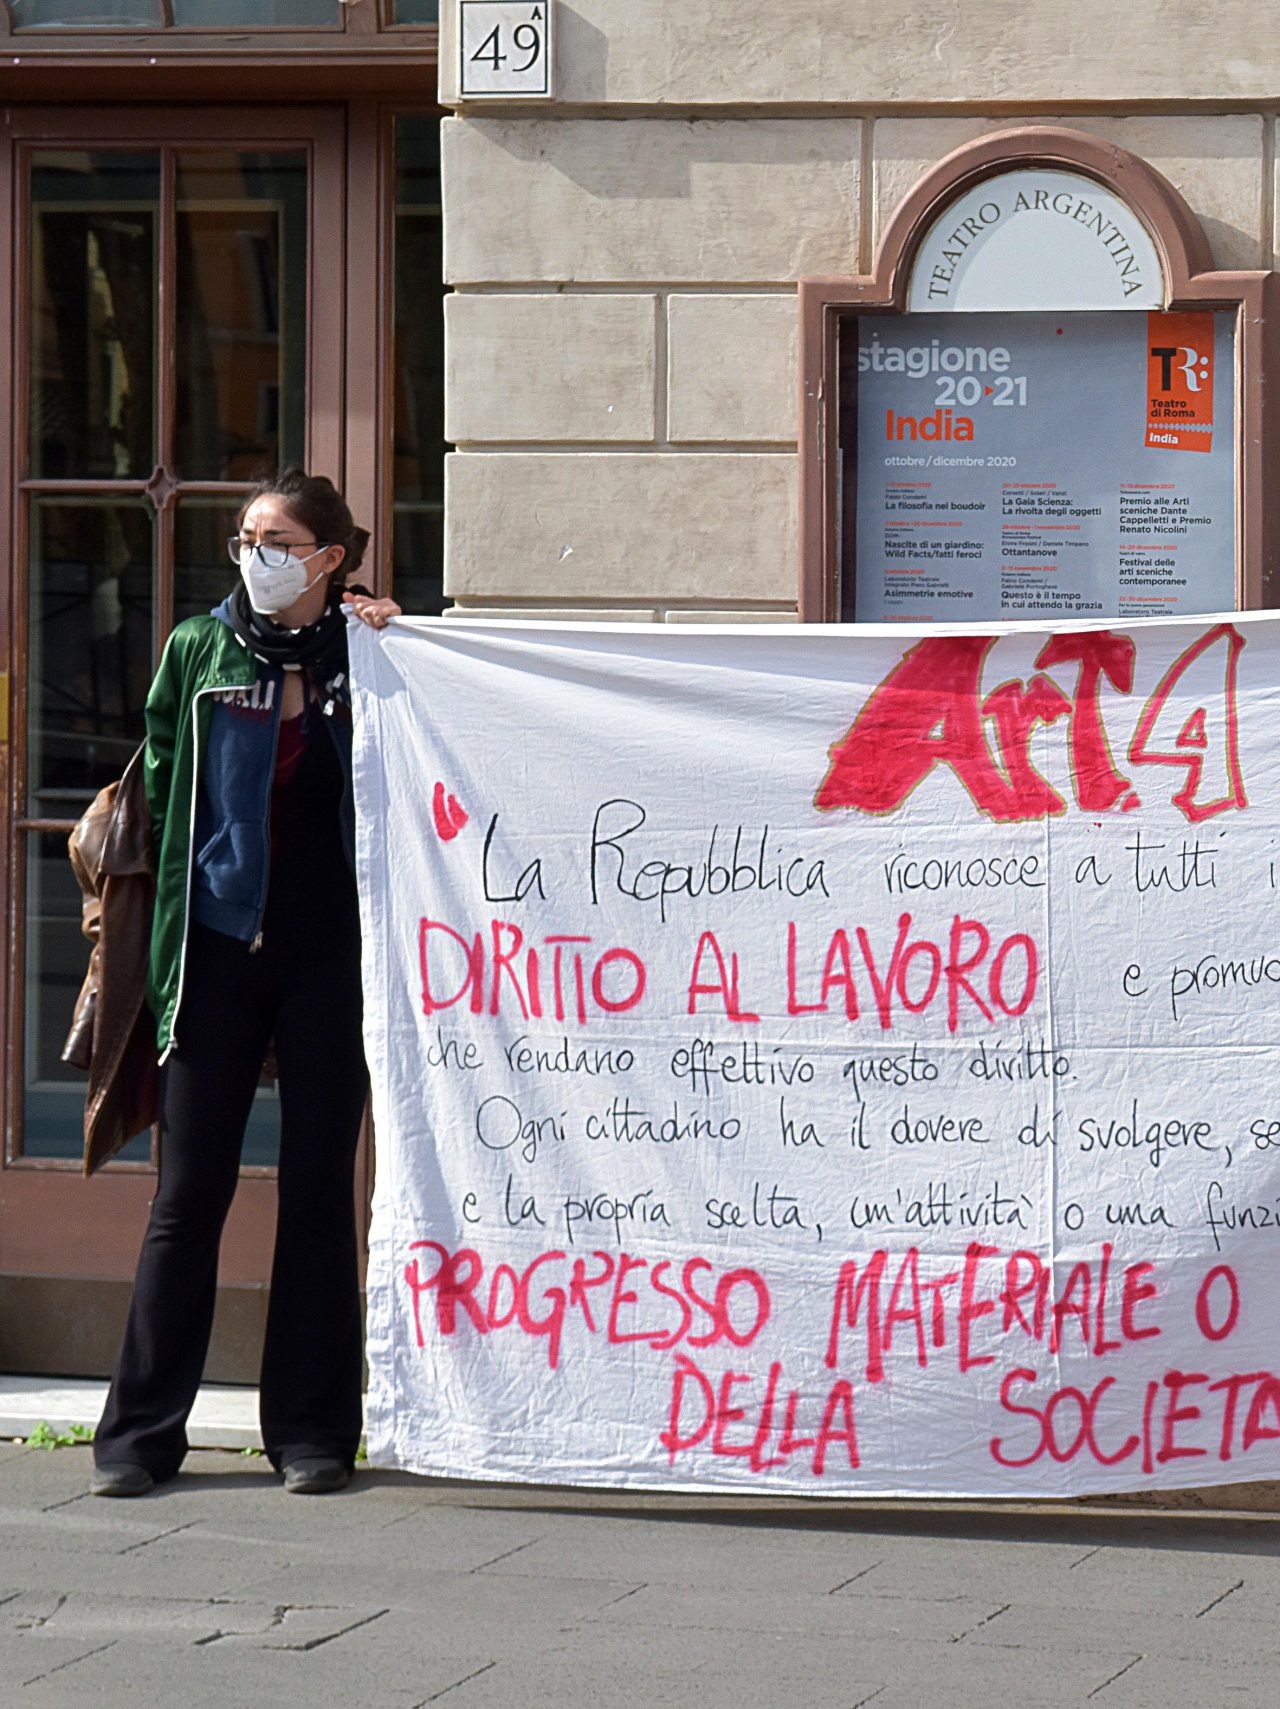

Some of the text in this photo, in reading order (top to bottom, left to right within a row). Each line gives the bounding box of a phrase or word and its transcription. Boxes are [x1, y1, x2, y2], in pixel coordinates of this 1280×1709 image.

[470, 24, 540, 72] 49
[928, 190, 1143, 300] TEATRO ARGENTINA
[858, 339, 1011, 378] stagione
[1151, 399, 1187, 408] Teatro
[1151, 409, 1195, 418] di Roma
[886, 409, 974, 441] India
[1149, 432, 1179, 444] India
[987, 457, 1017, 467] 2020
[885, 501, 986, 510] La filosofia nel boudoir
[1002, 498, 1073, 506] La Gaia Scienza:
[1120, 498, 1189, 506] Premio alle Arti
[1002, 507, 1102, 517] La rivolta degli oggetti
[1120, 507, 1187, 515] sceniche Dante
[1120, 516, 1169, 525] Cappelletti
[1120, 526, 1187, 534] Renato Nicolini
[884, 541, 917, 549] Nascite
[920, 541, 929, 549] di
[944, 541, 984, 550] giardino:
[884, 550, 982, 559] Wild Facts/fatti feroci
[1002, 548, 1057, 557] Ottantanove
[1136, 568, 1173, 576] sceniche
[1119, 578, 1187, 587] contemporanee
[884, 590, 973, 598] Asimmetrie emotive
[1002, 591, 1033, 600] Questo
[1044, 591, 1049, 599] il
[1052, 592, 1081, 601] tempo
[1002, 601, 1103, 610] in cui attendo la grazia
[1128, 622, 1248, 822] 4
[591, 798, 830, 922] Repubblica
[885, 843, 1046, 893] riconosce
[1075, 855, 1112, 886] a
[1125, 832, 1227, 892] tutti
[1269, 840, 1276, 888] i
[419, 916, 647, 1025] DIRITTO
[688, 930, 761, 1023] AL
[788, 912, 1038, 1033] LAVORO
[1123, 963, 1147, 997] e
[427, 1024, 483, 1070] che
[504, 1035, 635, 1075] rendano
[671, 1038, 815, 1096] effettivo
[843, 1042, 939, 1102] questo
[476, 1094, 567, 1163] Ogni
[585, 1096, 741, 1143] cittadino
[780, 1096, 824, 1148] ha
[851, 1100, 870, 1150] il
[891, 1104, 990, 1143] dovere
[1019, 1104, 1061, 1146] di
[1079, 1098, 1233, 1168] svolgere,
[463, 1191, 482, 1222] e
[505, 1173, 545, 1226] la
[564, 1189, 671, 1245] propria
[1065, 1203, 1084, 1230] o
[1105, 1202, 1174, 1228] una
[404, 1239, 771, 1371] PROGRESSO
[825, 1242, 1161, 1382] MATERIALE
[1195, 1264, 1241, 1341] O
[659, 1352, 861, 1476] DELLA
